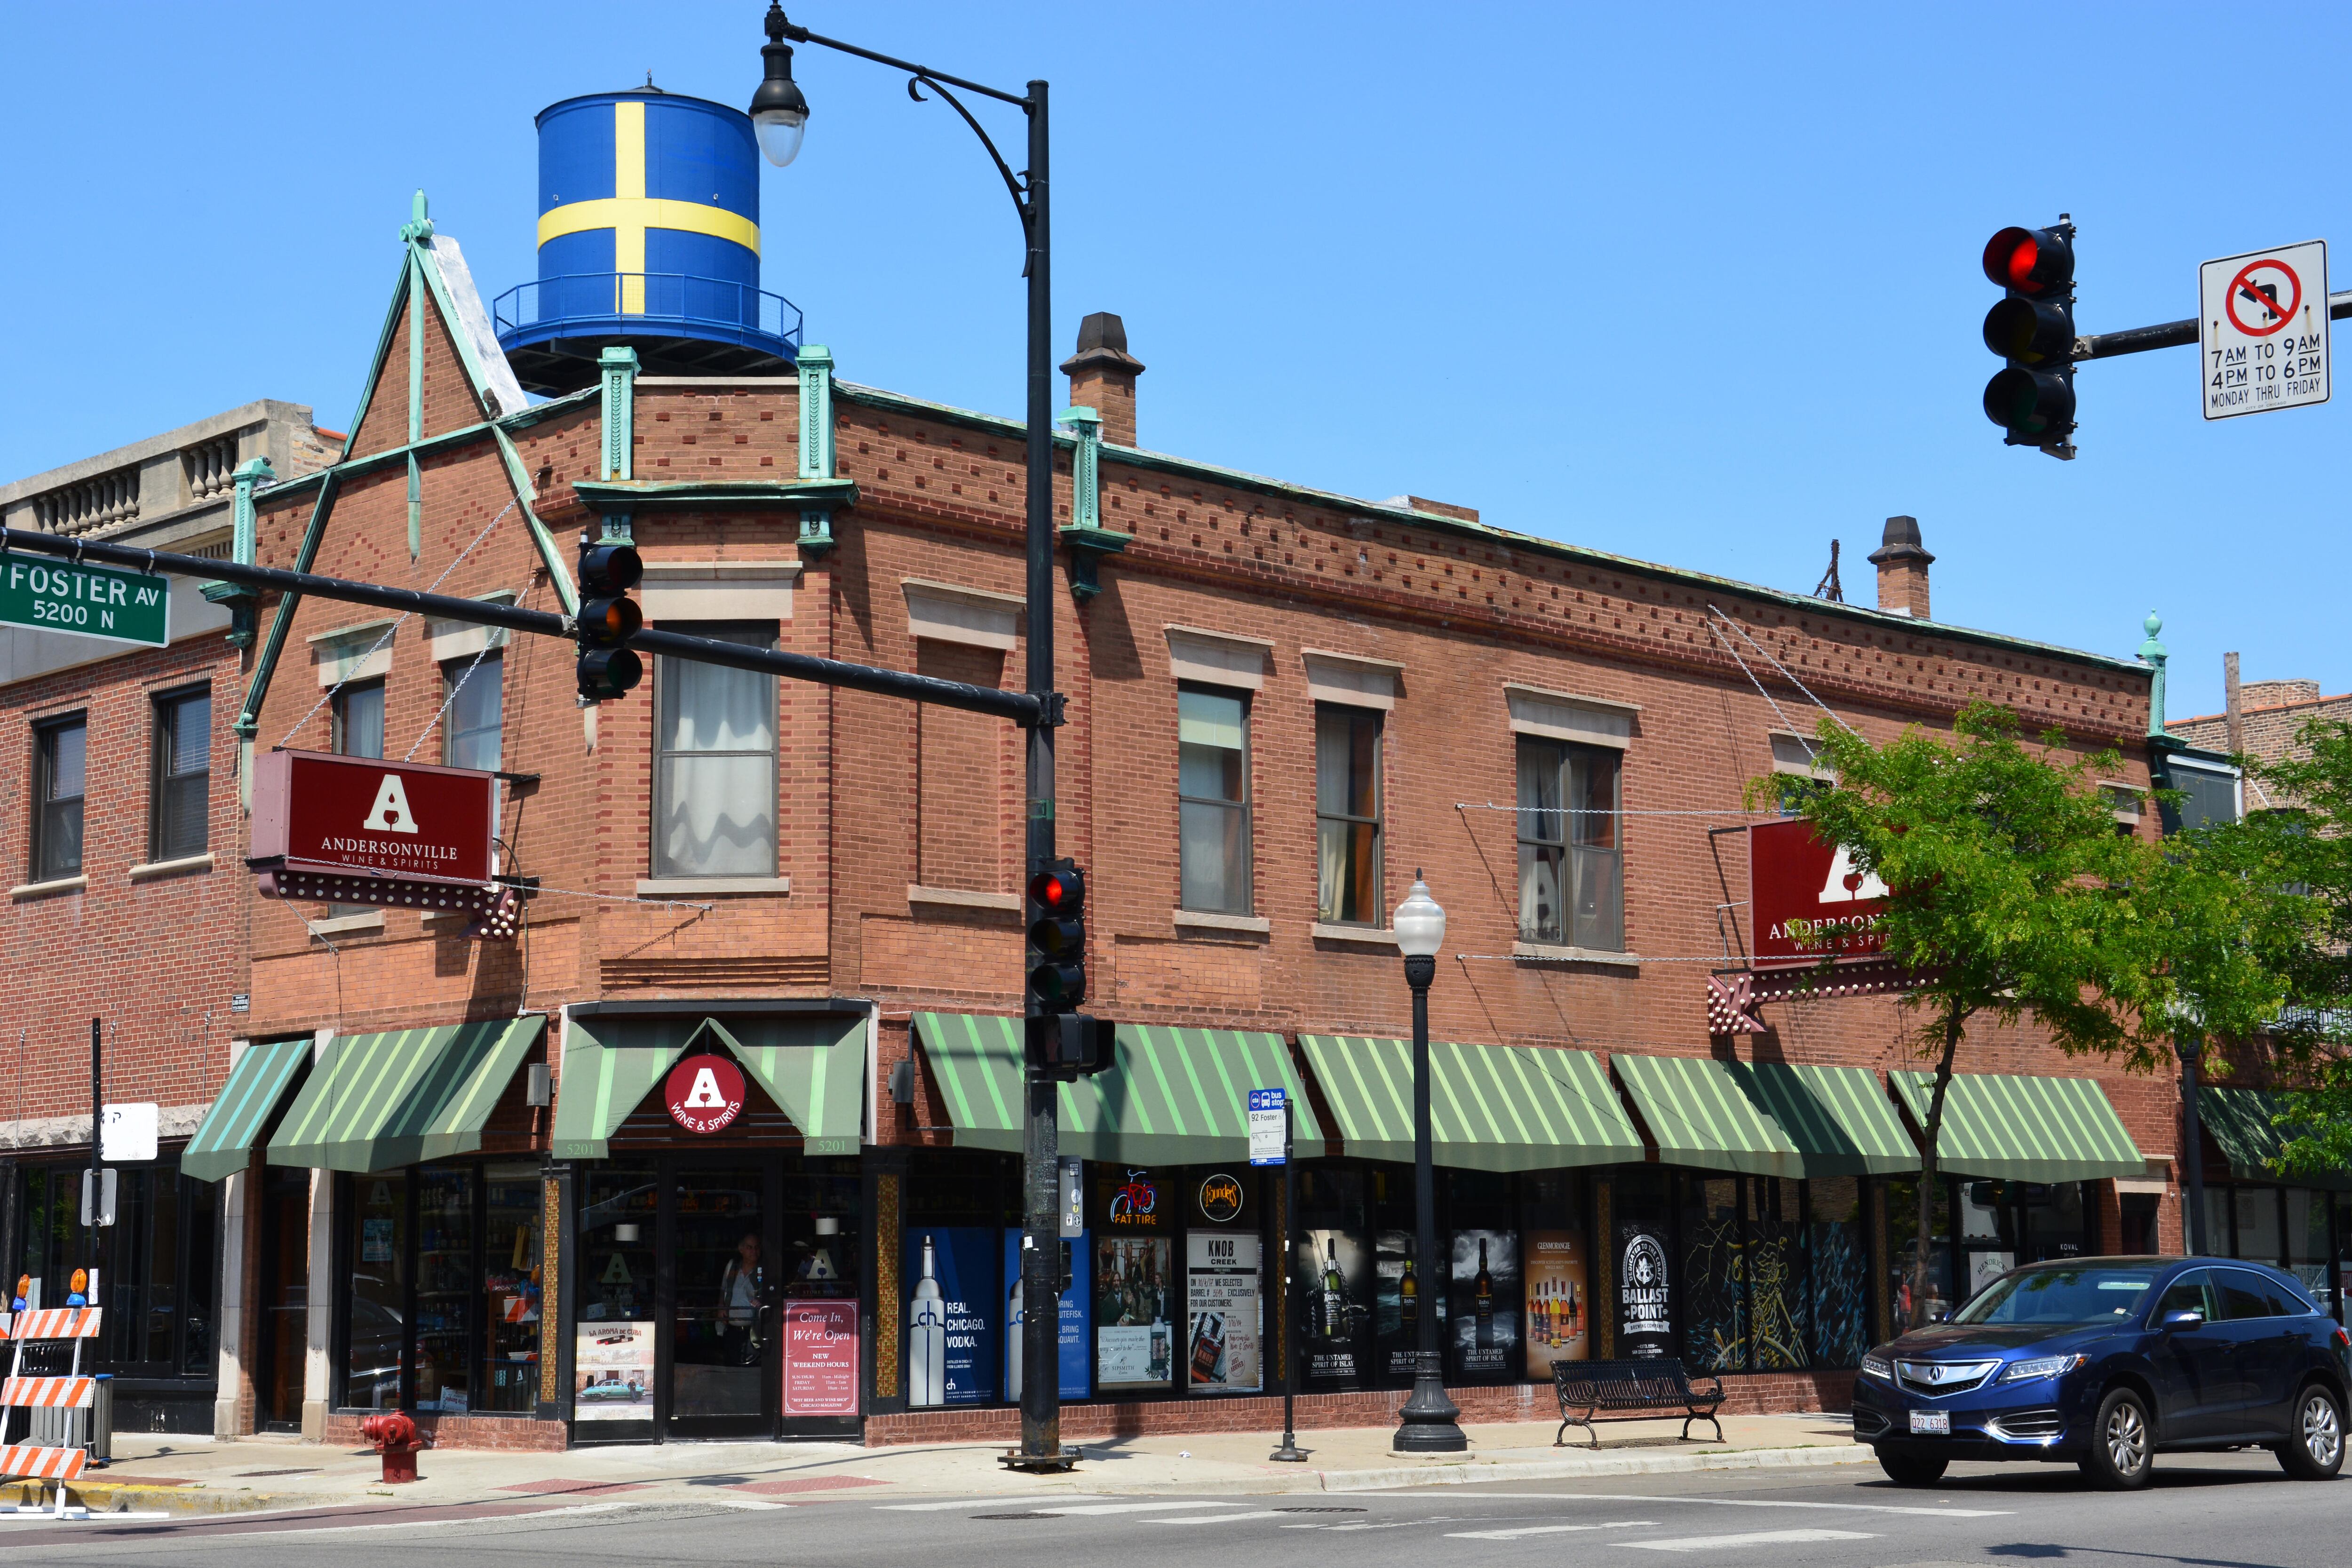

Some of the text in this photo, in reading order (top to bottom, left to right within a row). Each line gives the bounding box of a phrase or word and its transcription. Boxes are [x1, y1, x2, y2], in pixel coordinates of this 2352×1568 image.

[2211, 333, 2320, 368] 7AM TO 9AM
[2211, 356, 2320, 390] 4PM TO 6PM
[2211, 378, 2320, 408] MONDAY THRU FRIDAY
[10, 563, 126, 606] FOSTER
[135, 588, 159, 606] AV
[33, 600, 114, 629] 5200 N
[364, 774, 418, 834] A
[321, 837, 457, 860] ANDERSONVILLE
[342, 854, 438, 870] WINE & SPIRITS
[1795, 938, 1851, 951] WINE &
[684, 1068, 726, 1107] A
[1271, 1099, 1284, 1107] stop
[671, 1101, 740, 1131] WINE & SPIRITS
[566, 1144, 594, 1155] 5201
[818, 1140, 846, 1153] 5201
[1115, 1214, 1157, 1225] FAT TIRE
[1208, 1240, 1234, 1257] KNOB
[806, 1249, 838, 1279] A
[1628, 1244, 1641, 1281] DEDICATED
[1648, 1245, 1657, 1257] THE
[1622, 1288, 1669, 1304] BALLAST
[947, 1302, 971, 1313] REAL.
[1630, 1304, 1663, 1320] POINT
[800, 1312, 843, 1324] Come In,
[947, 1319, 985, 1331] CHICAGO.
[794, 1330, 850, 1344] We're Open
[947, 1336, 977, 1348] VODKA.
[1198, 1350, 1214, 1363] KNOB
[1231, 1361, 1244, 1372] ARRIVED
[1912, 1417, 1947, 1430] Q22 6318
